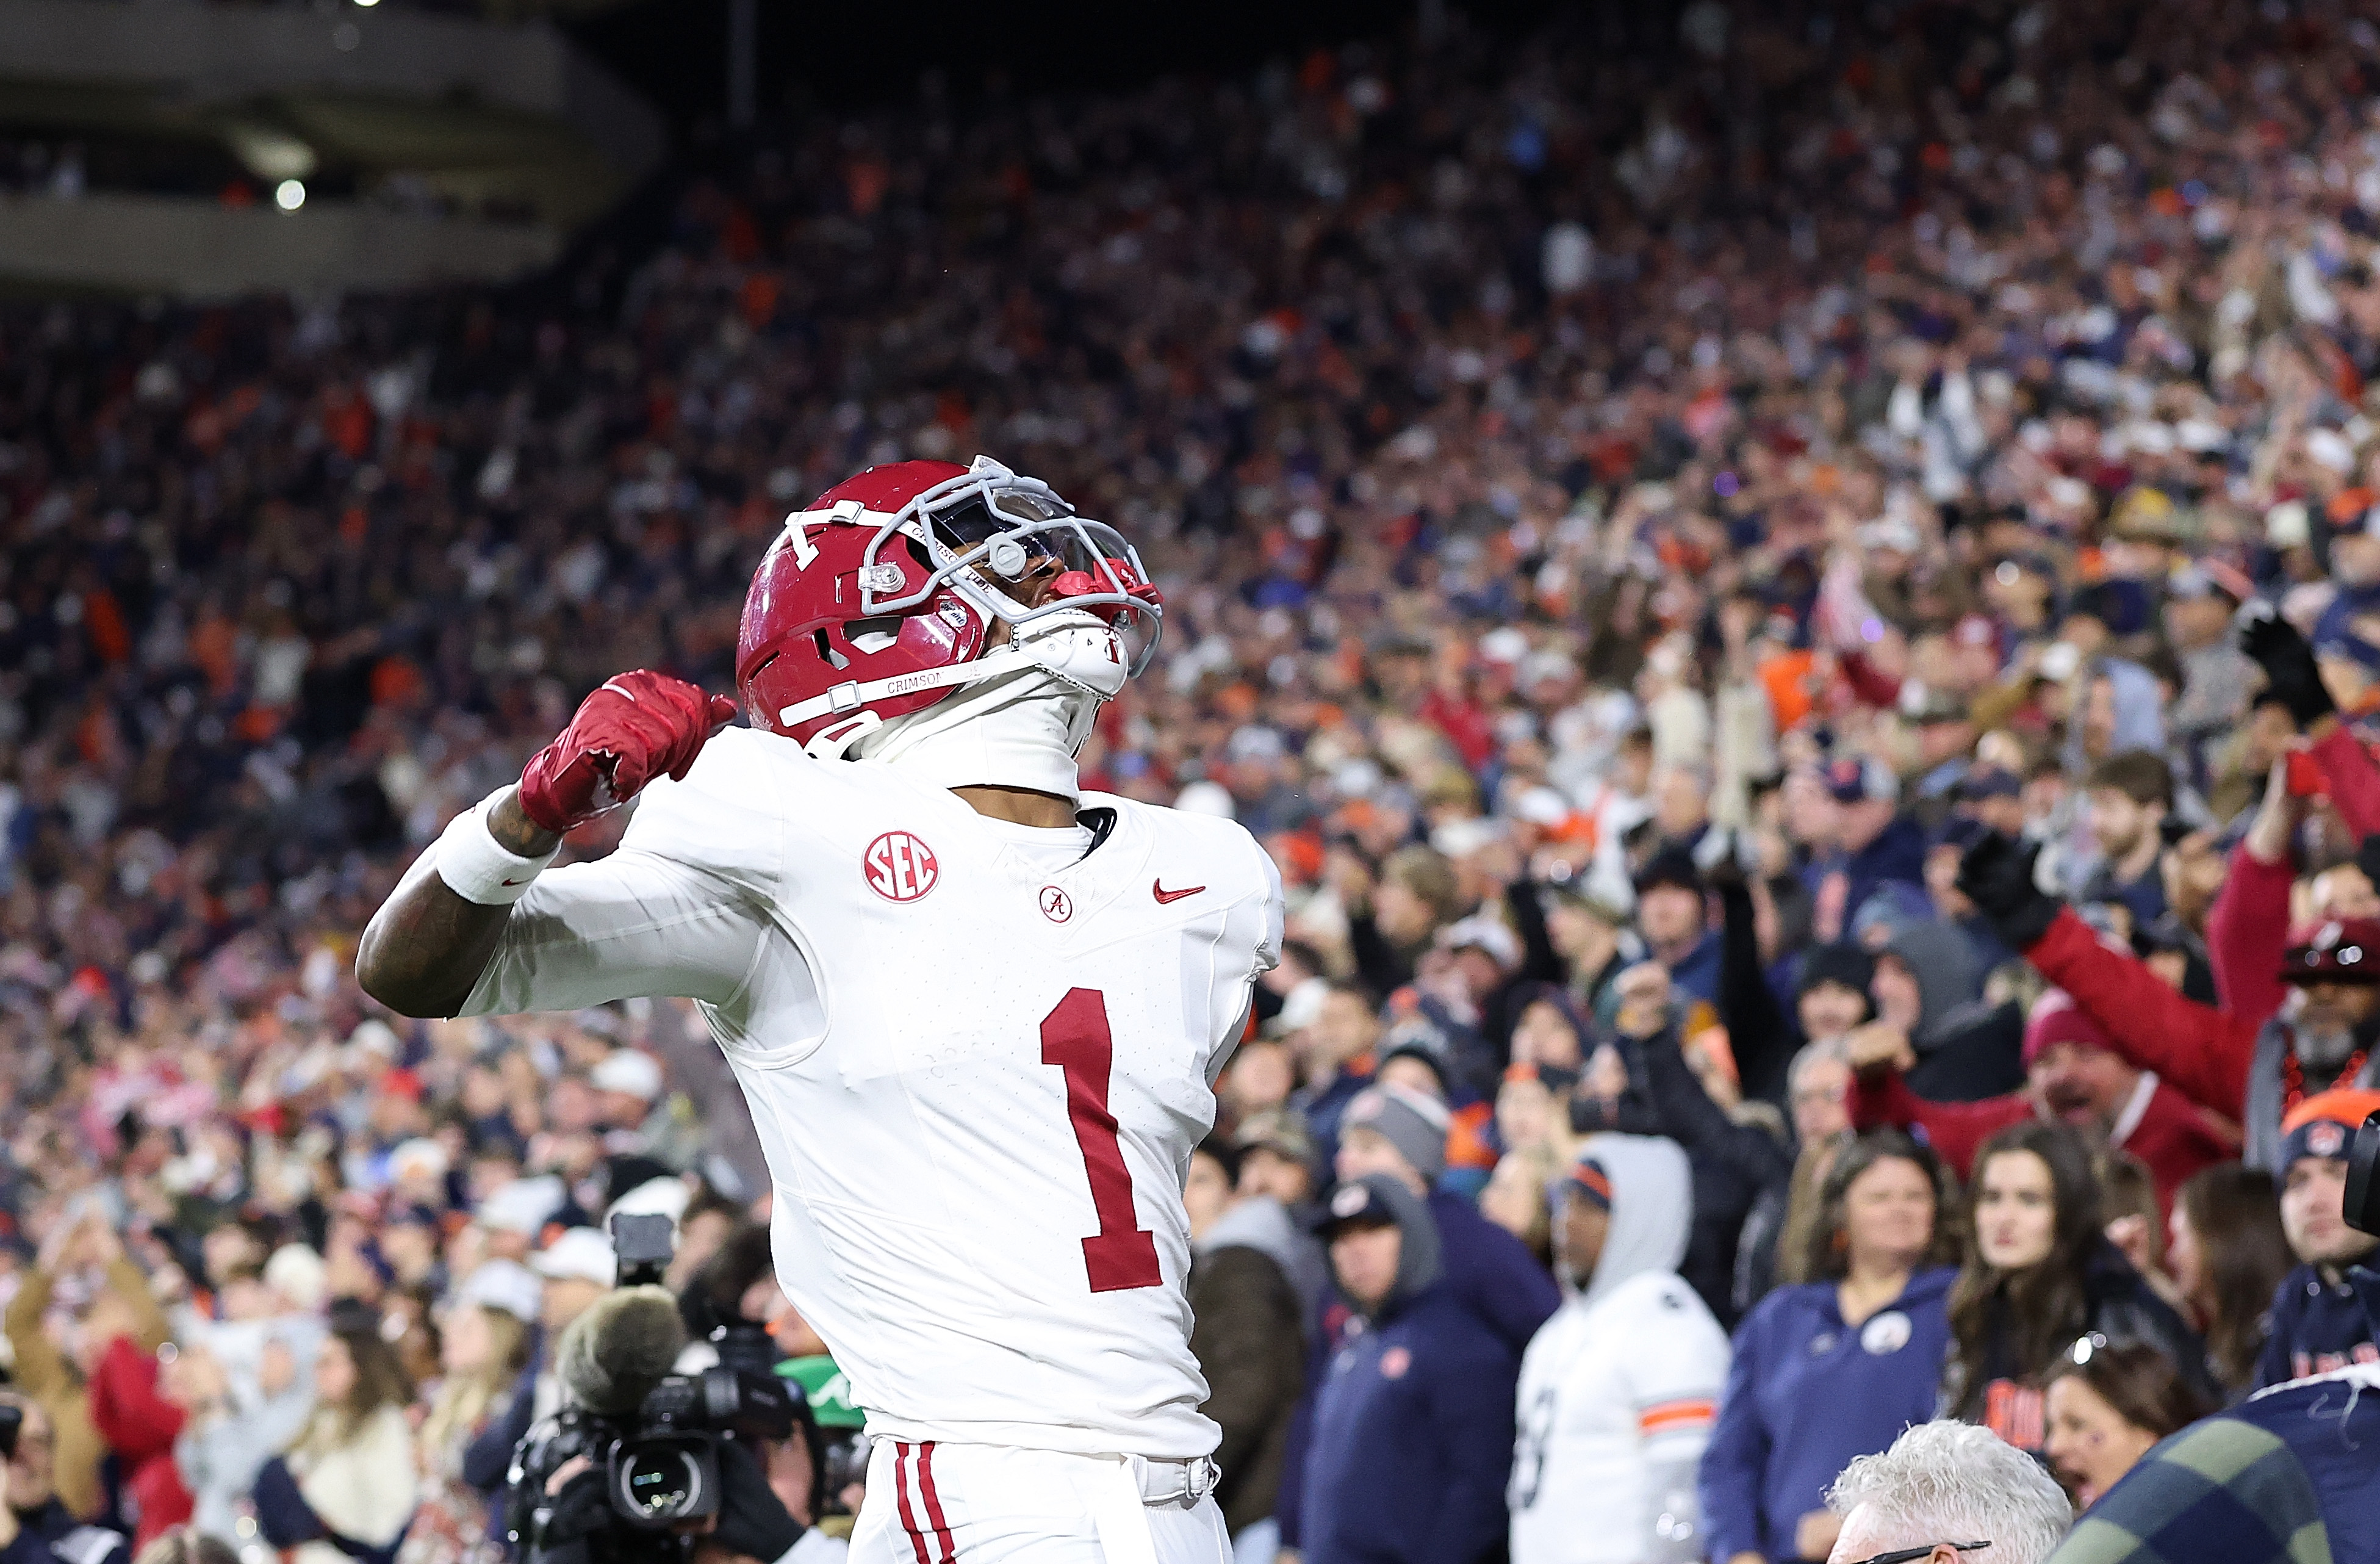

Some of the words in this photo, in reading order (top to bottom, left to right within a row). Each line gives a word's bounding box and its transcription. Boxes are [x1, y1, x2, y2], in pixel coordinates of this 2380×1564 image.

[888, 671, 944, 694] CRIMSON
[866, 833, 936, 899] SEC
[1044, 891, 1065, 915] A
[1040, 987, 1163, 1293] 1
